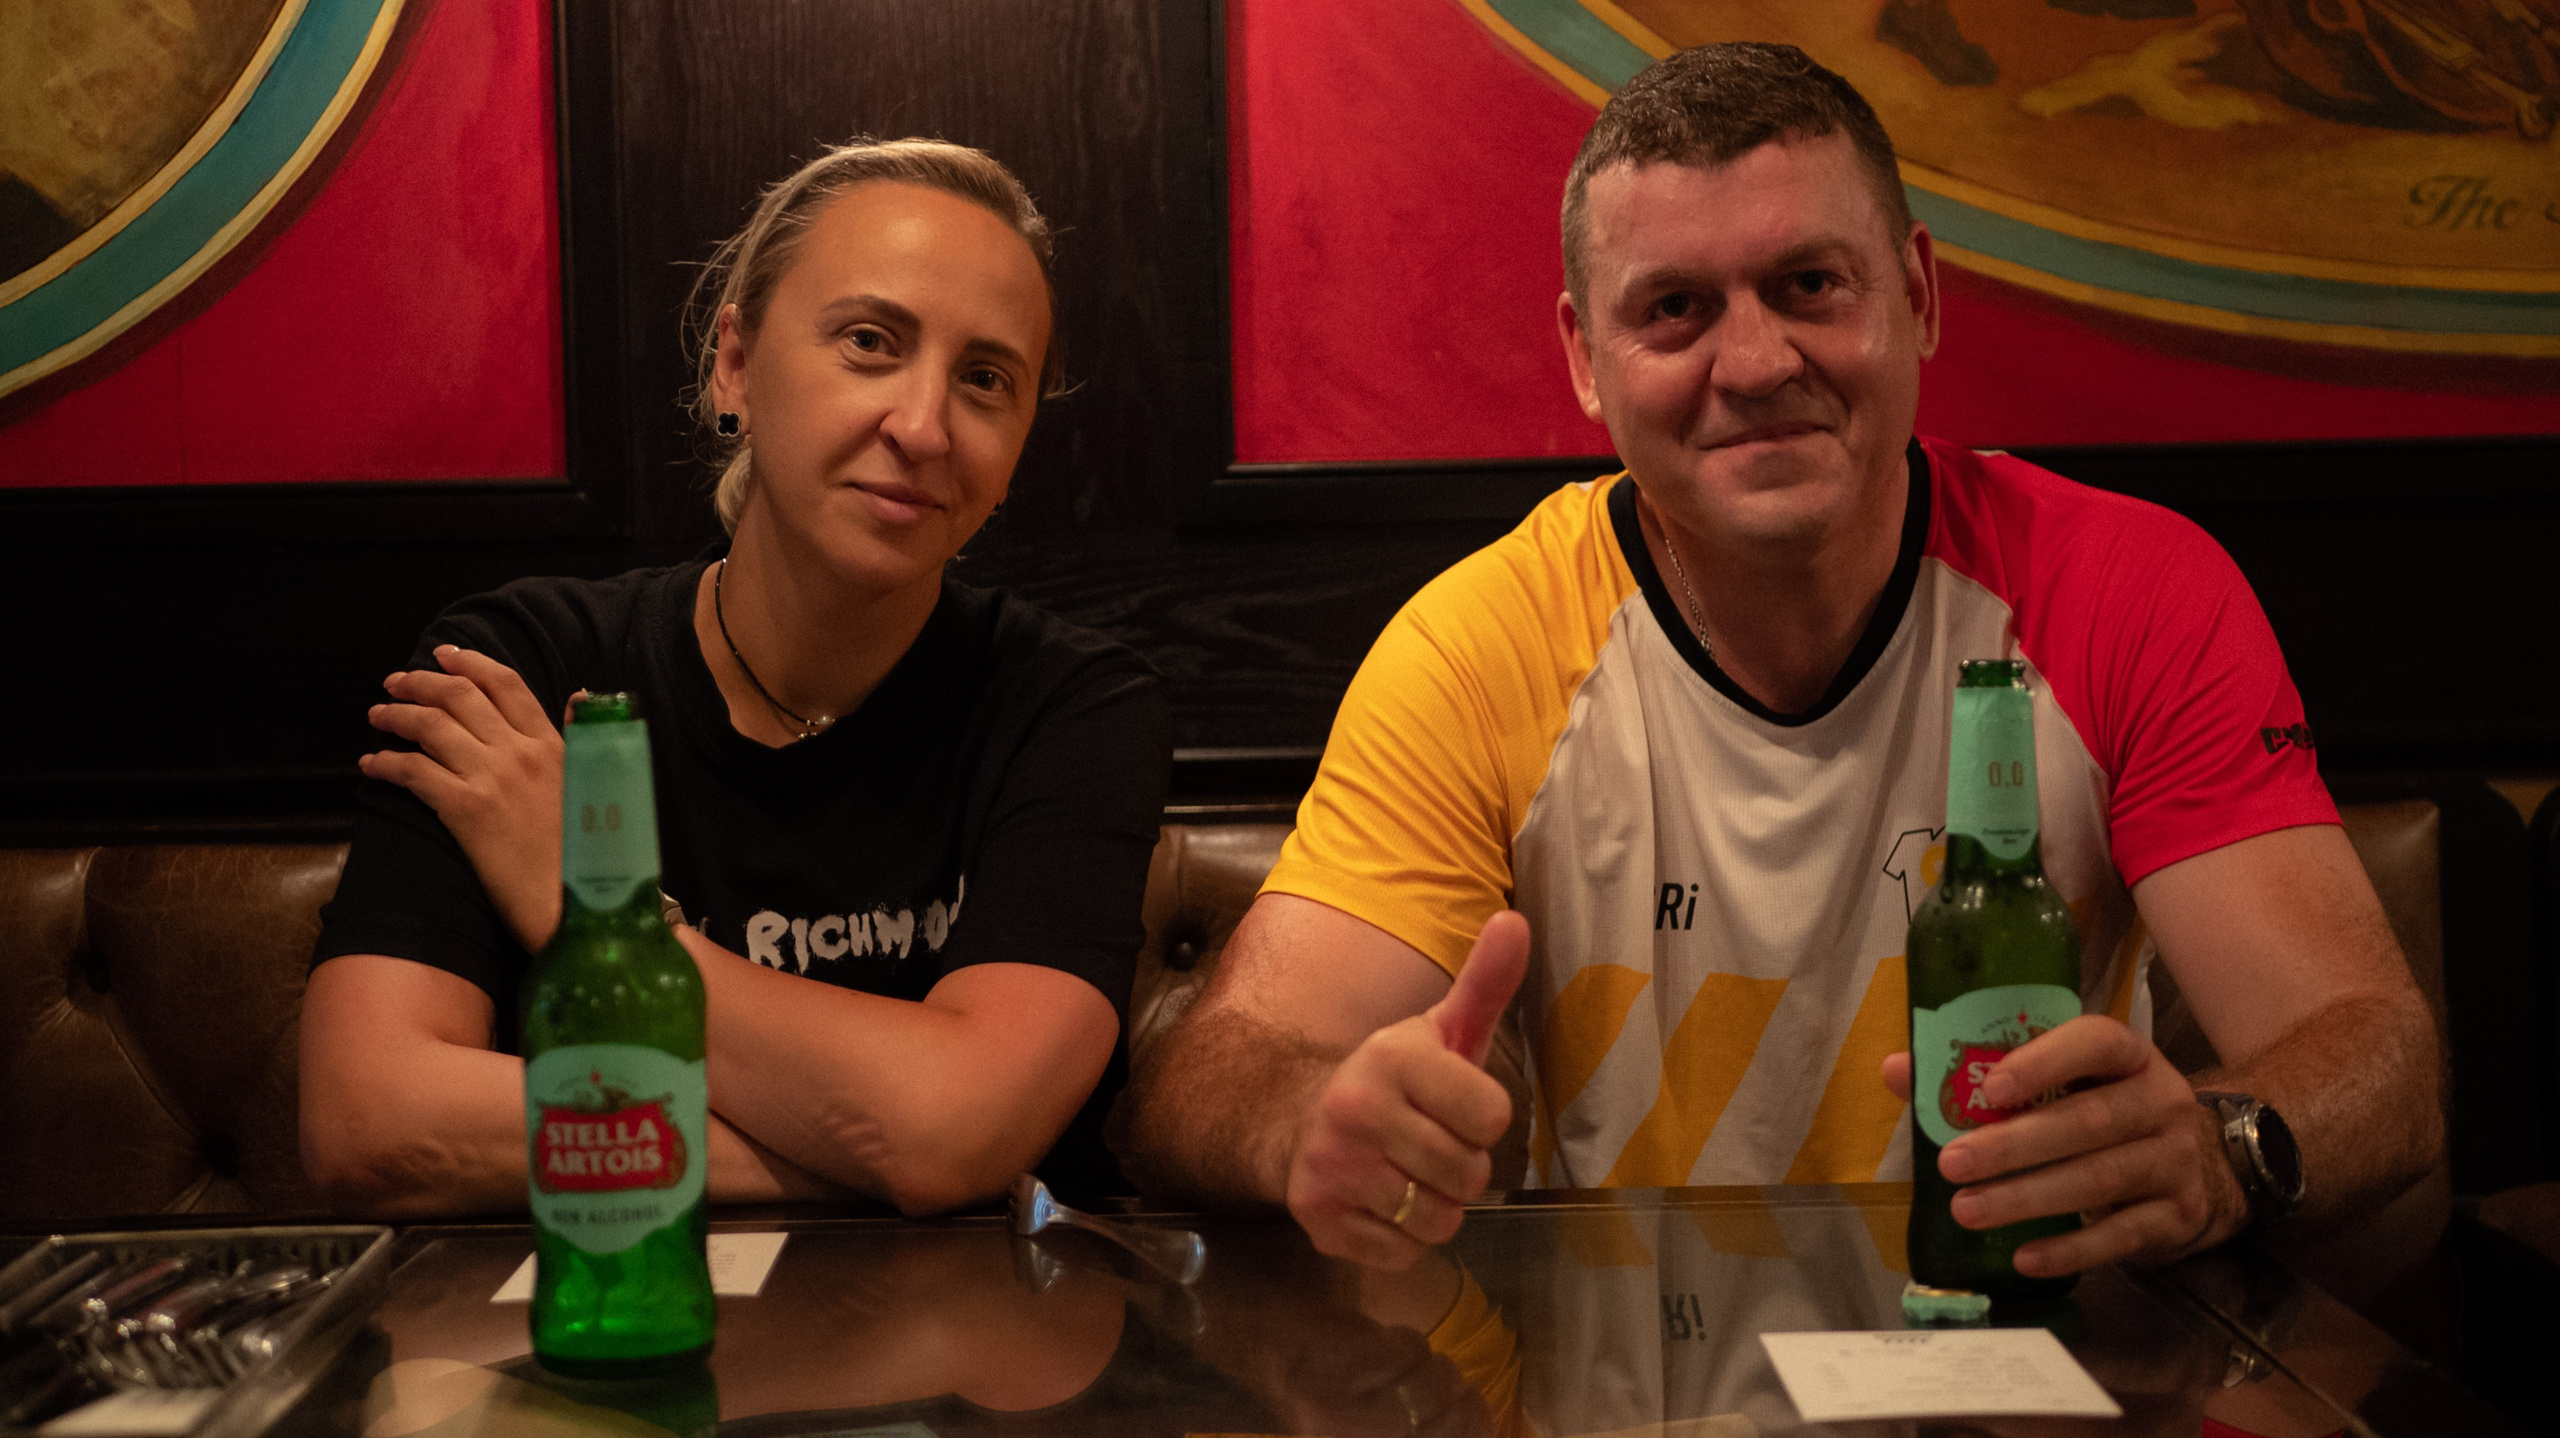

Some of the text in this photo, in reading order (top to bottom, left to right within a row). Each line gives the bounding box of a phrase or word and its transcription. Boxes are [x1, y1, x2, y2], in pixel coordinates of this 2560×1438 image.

[1988, 760, 2024, 788] 0.0
[746, 873, 965, 976] RICHMO
[546, 1119, 660, 1147] STELLA
[547, 1145, 663, 1176] ARTOIS
